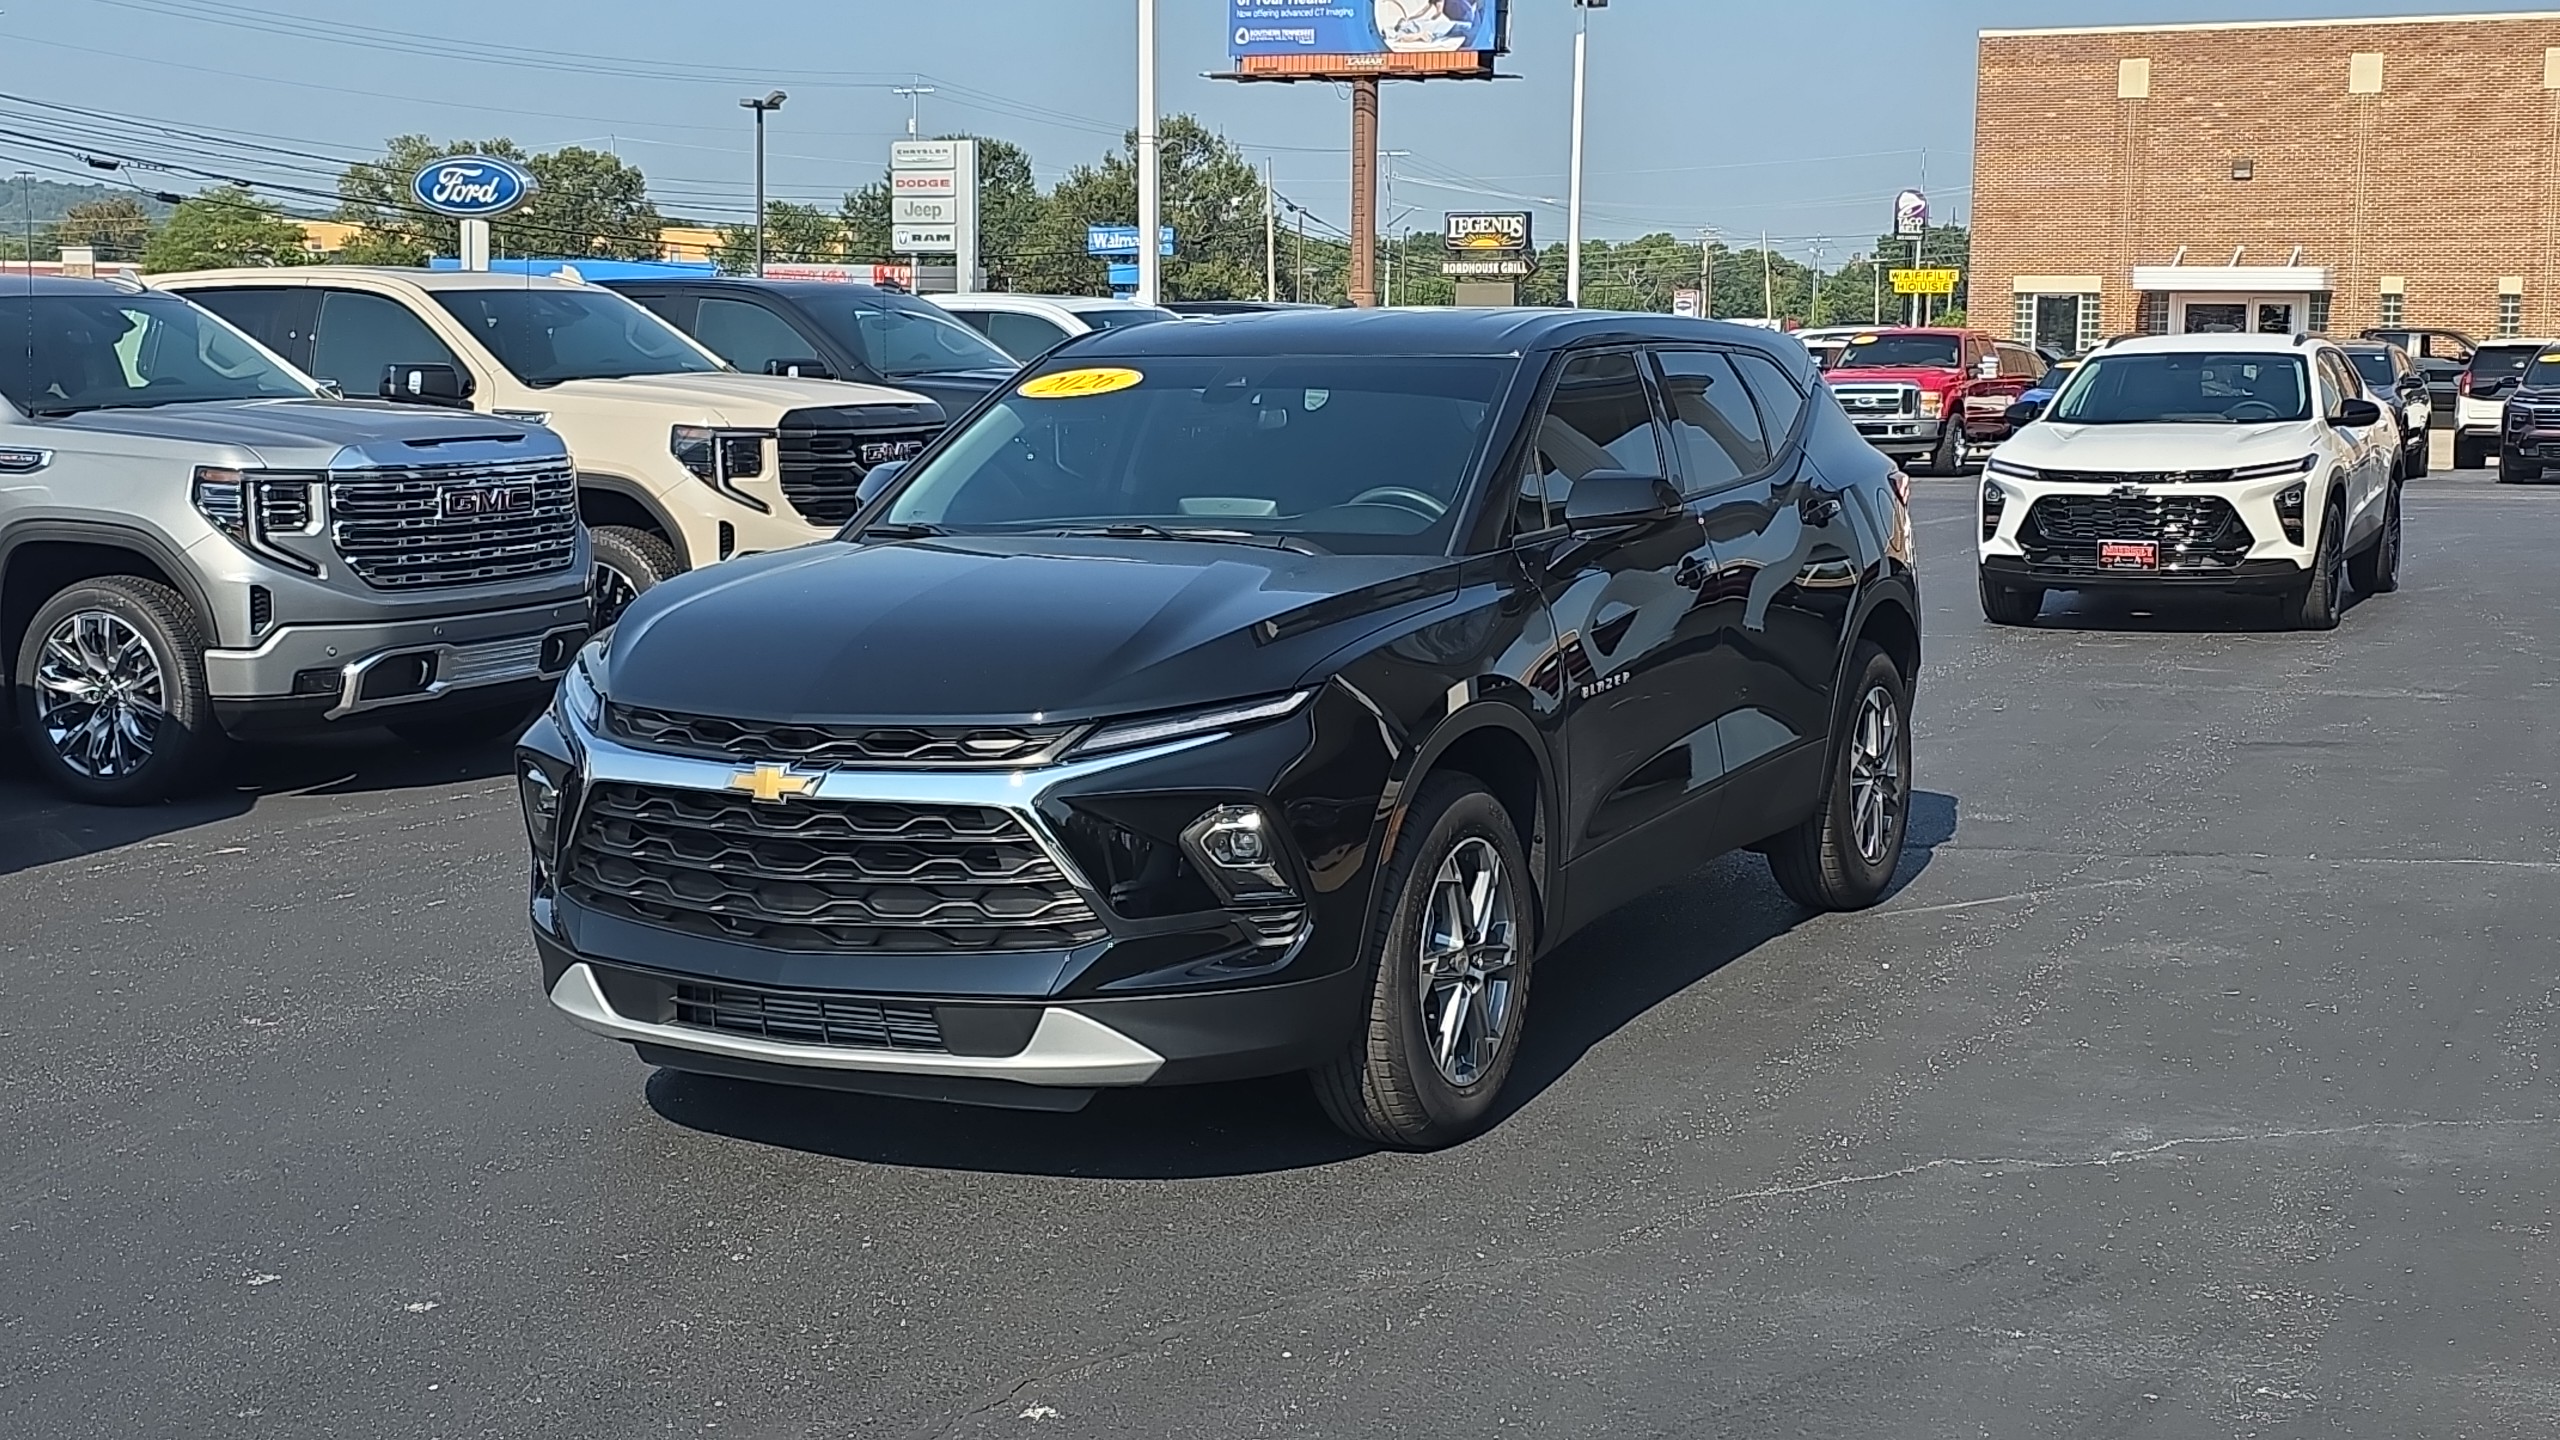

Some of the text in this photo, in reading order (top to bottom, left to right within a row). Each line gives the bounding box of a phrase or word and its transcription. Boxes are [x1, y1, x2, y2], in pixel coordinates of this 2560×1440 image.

[1253, 9, 1279, 19] offering
[1281, 8, 1313, 17] advanced
[1315, 8, 1325, 16] CT
[433, 167, 500, 203] Ford
[904, 201, 942, 220] Jeep
[1448, 216, 1524, 238] LEGENDS
[1897, 217, 1923, 226] TACO
[912, 234, 951, 242] RAM
[1093, 232, 1140, 249] Walma
[1442, 261, 1528, 274] ROADHOUSE GRILL
[1891, 271, 1957, 280] WAFFLE
[1897, 282, 1951, 291] HOUSE
[1031, 372, 1130, 394] 2026
[862, 440, 924, 463] GMC
[444, 486, 531, 515] GMC
[1581, 671, 1630, 699] BLAZER
